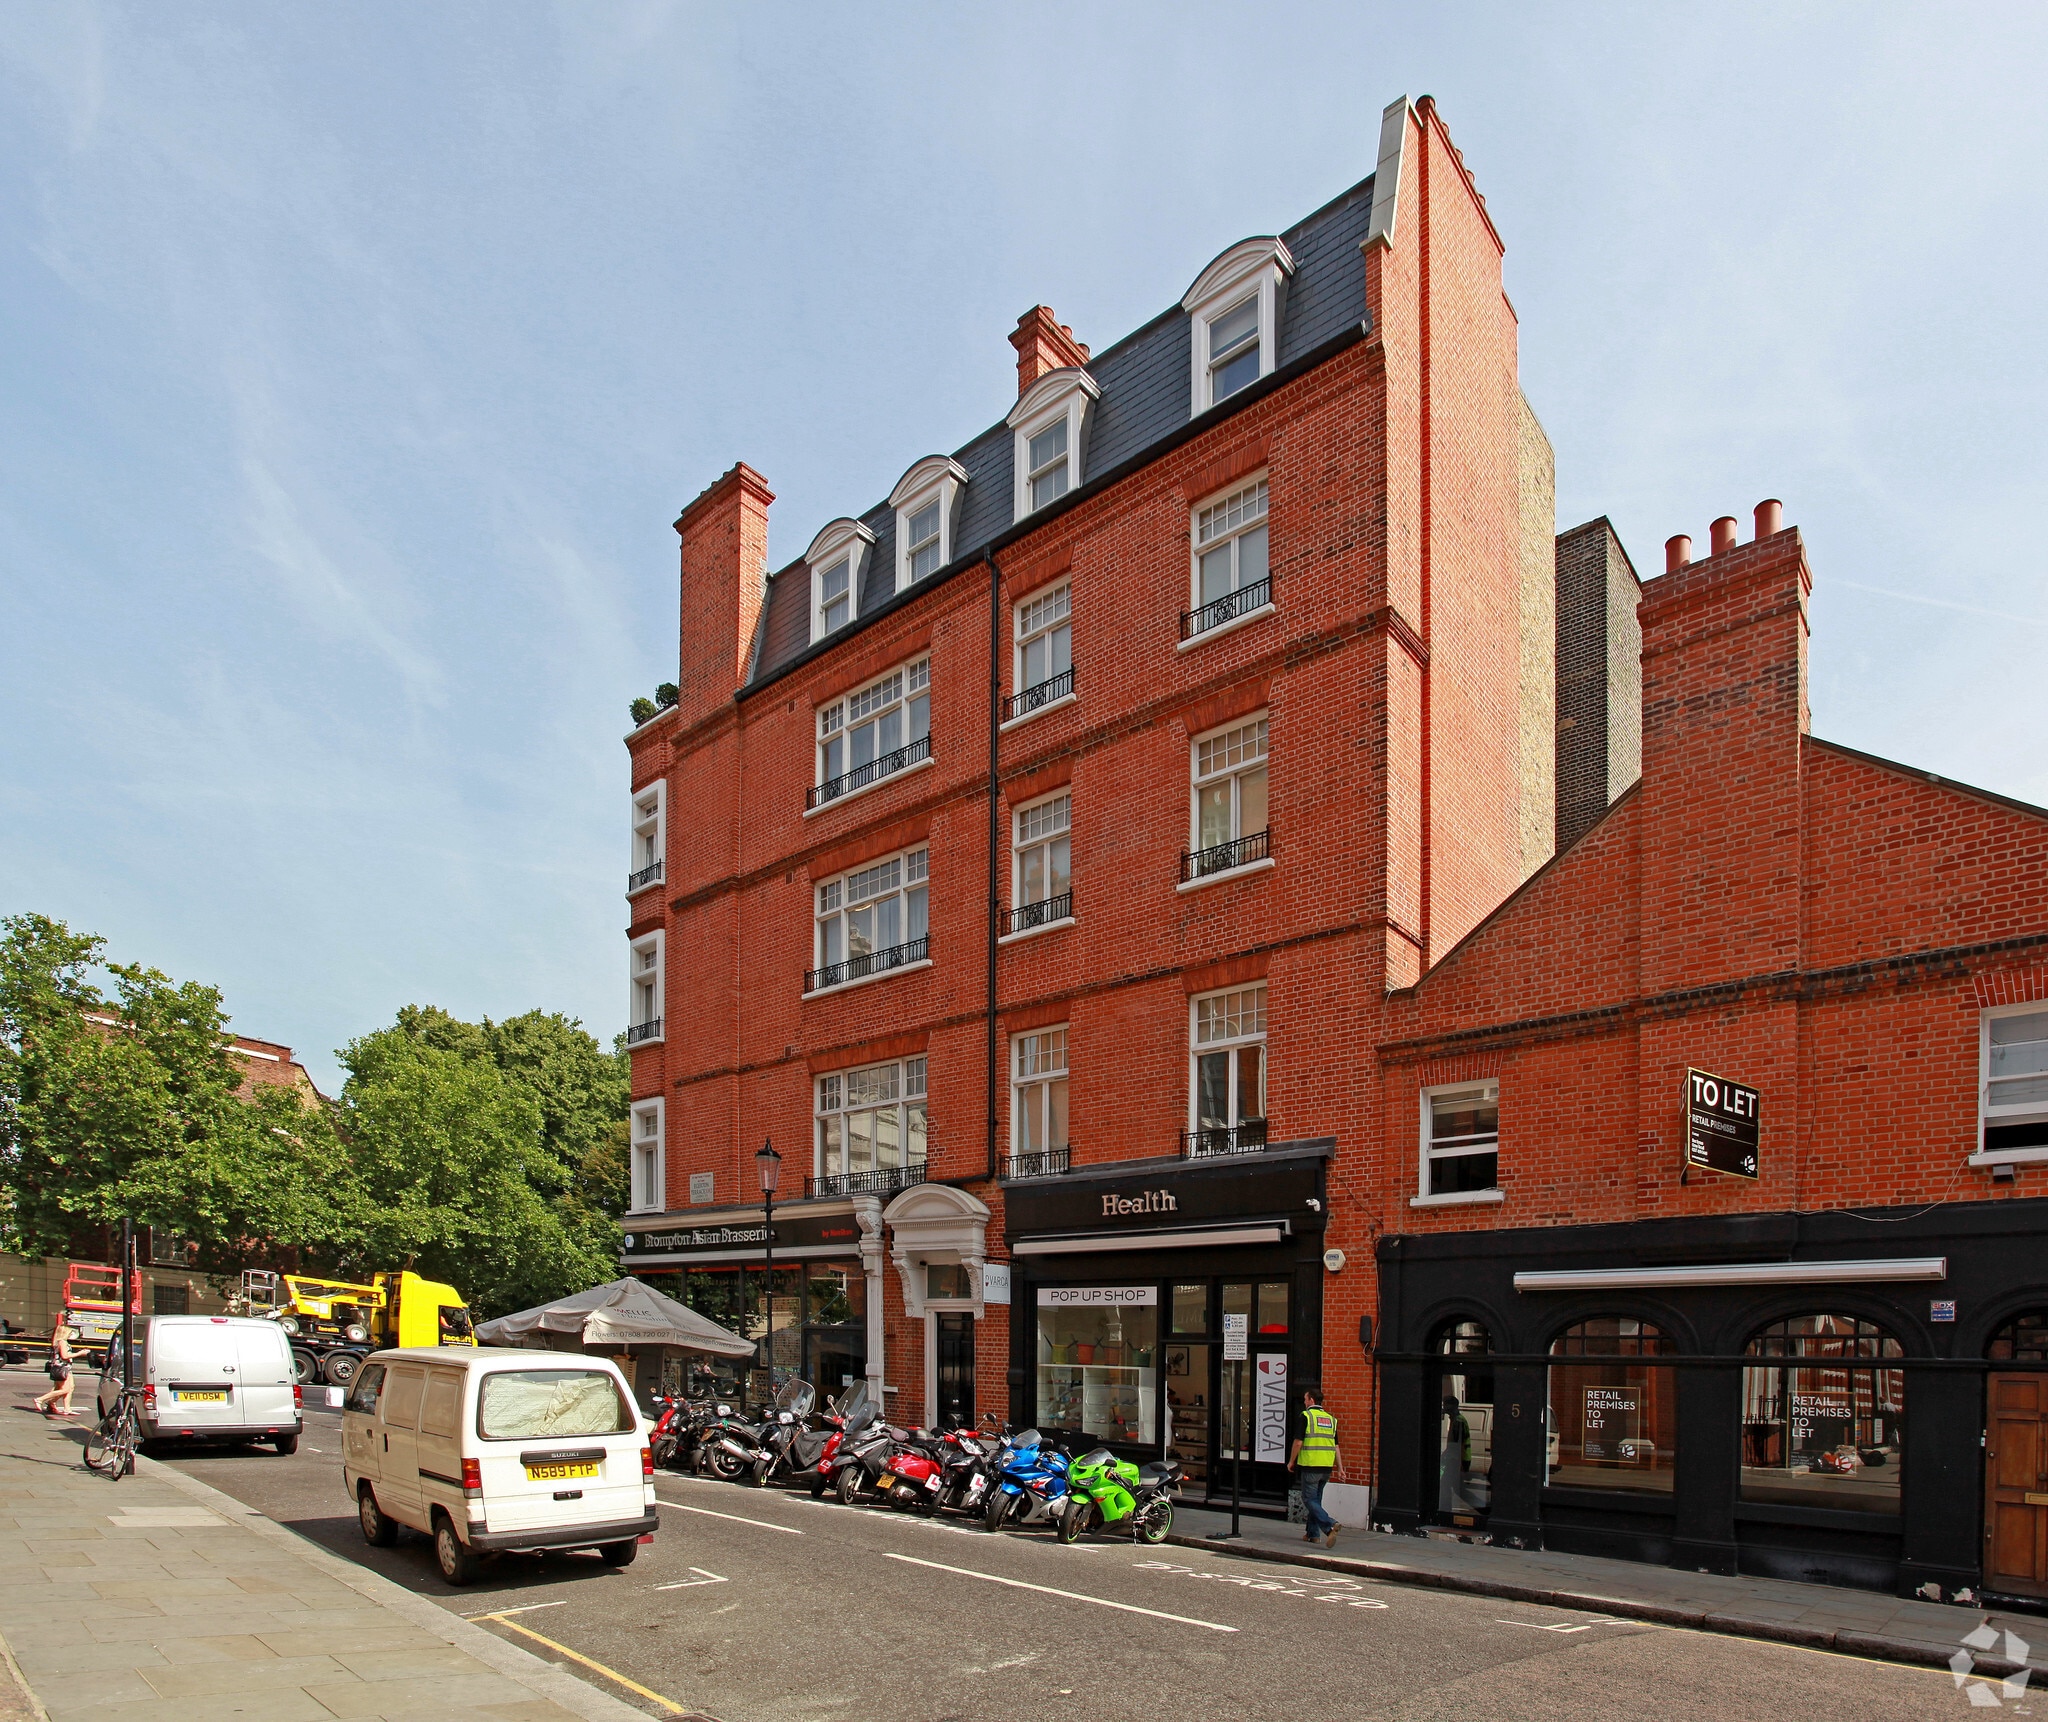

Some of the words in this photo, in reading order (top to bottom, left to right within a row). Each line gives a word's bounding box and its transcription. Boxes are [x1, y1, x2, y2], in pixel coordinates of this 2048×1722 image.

[1693, 1076, 1719, 1106] TO
[1724, 1086, 1757, 1117] LET
[1692, 1114, 1710, 1127] RETAIL
[1710, 1120, 1737, 1134] PREMISES
[1101, 1189, 1178, 1216] Health
[644, 1233, 690, 1250] Brompton
[691, 1229, 720, 1244] Asian
[1050, 1291, 1078, 1302] POP
[1082, 1291, 1101, 1301] UP
[1104, 1290, 1146, 1301] SHOP
[591, 1330, 618, 1338] Flowers:
[1587, 1390, 1621, 1400] RETAIL
[1587, 1400, 1636, 1410] PREMISES
[1792, 1396, 1833, 1406] RETAIL
[1262, 1379, 1286, 1452] VARCA
[1511, 1403, 1521, 1418] 5
[1586, 1410, 1601, 1418] TO
[1792, 1407, 1851, 1417] PREMISES
[1586, 1420, 1605, 1428] LET
[1792, 1418, 1809, 1426] TO
[1792, 1429, 1814, 1437] LET
[531, 1466, 566, 1479] N589
[569, 1463, 594, 1476] FTP
[931, 1476, 940, 1487] L
